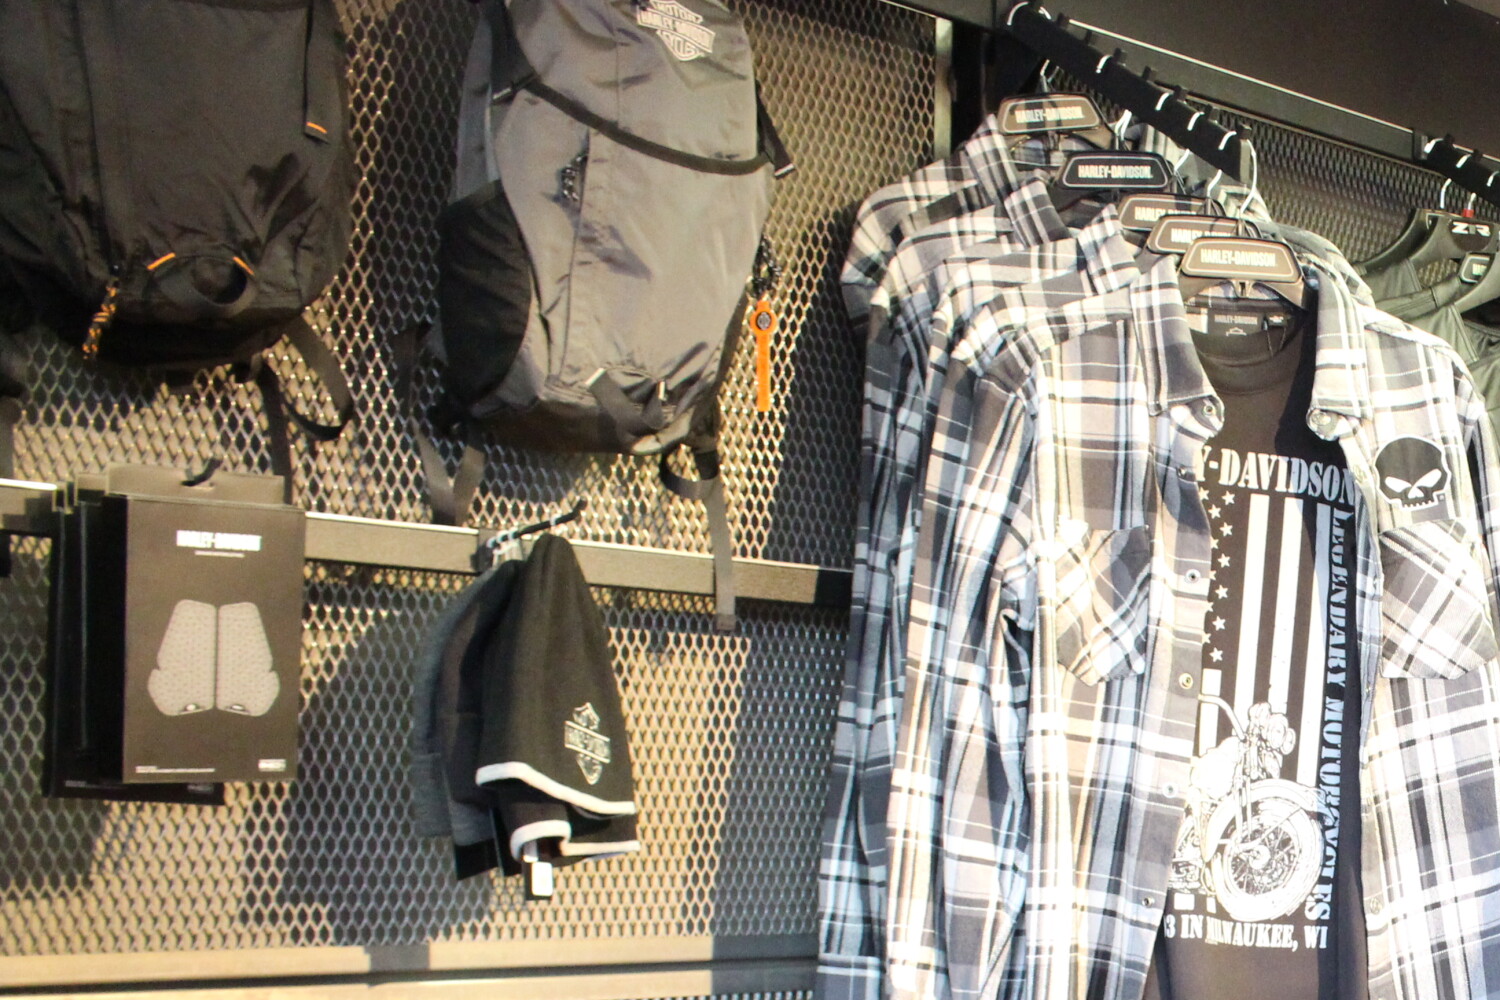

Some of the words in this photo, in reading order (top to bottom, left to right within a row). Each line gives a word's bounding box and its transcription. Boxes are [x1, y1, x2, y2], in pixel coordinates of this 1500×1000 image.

[1078, 164, 1153, 179] HARLEY-DAVIDSON
[1200, 248, 1277, 268] HARLEY-DAVIDSON
[1180, 914, 1204, 939] IN
[1304, 925, 1329, 949] WI
